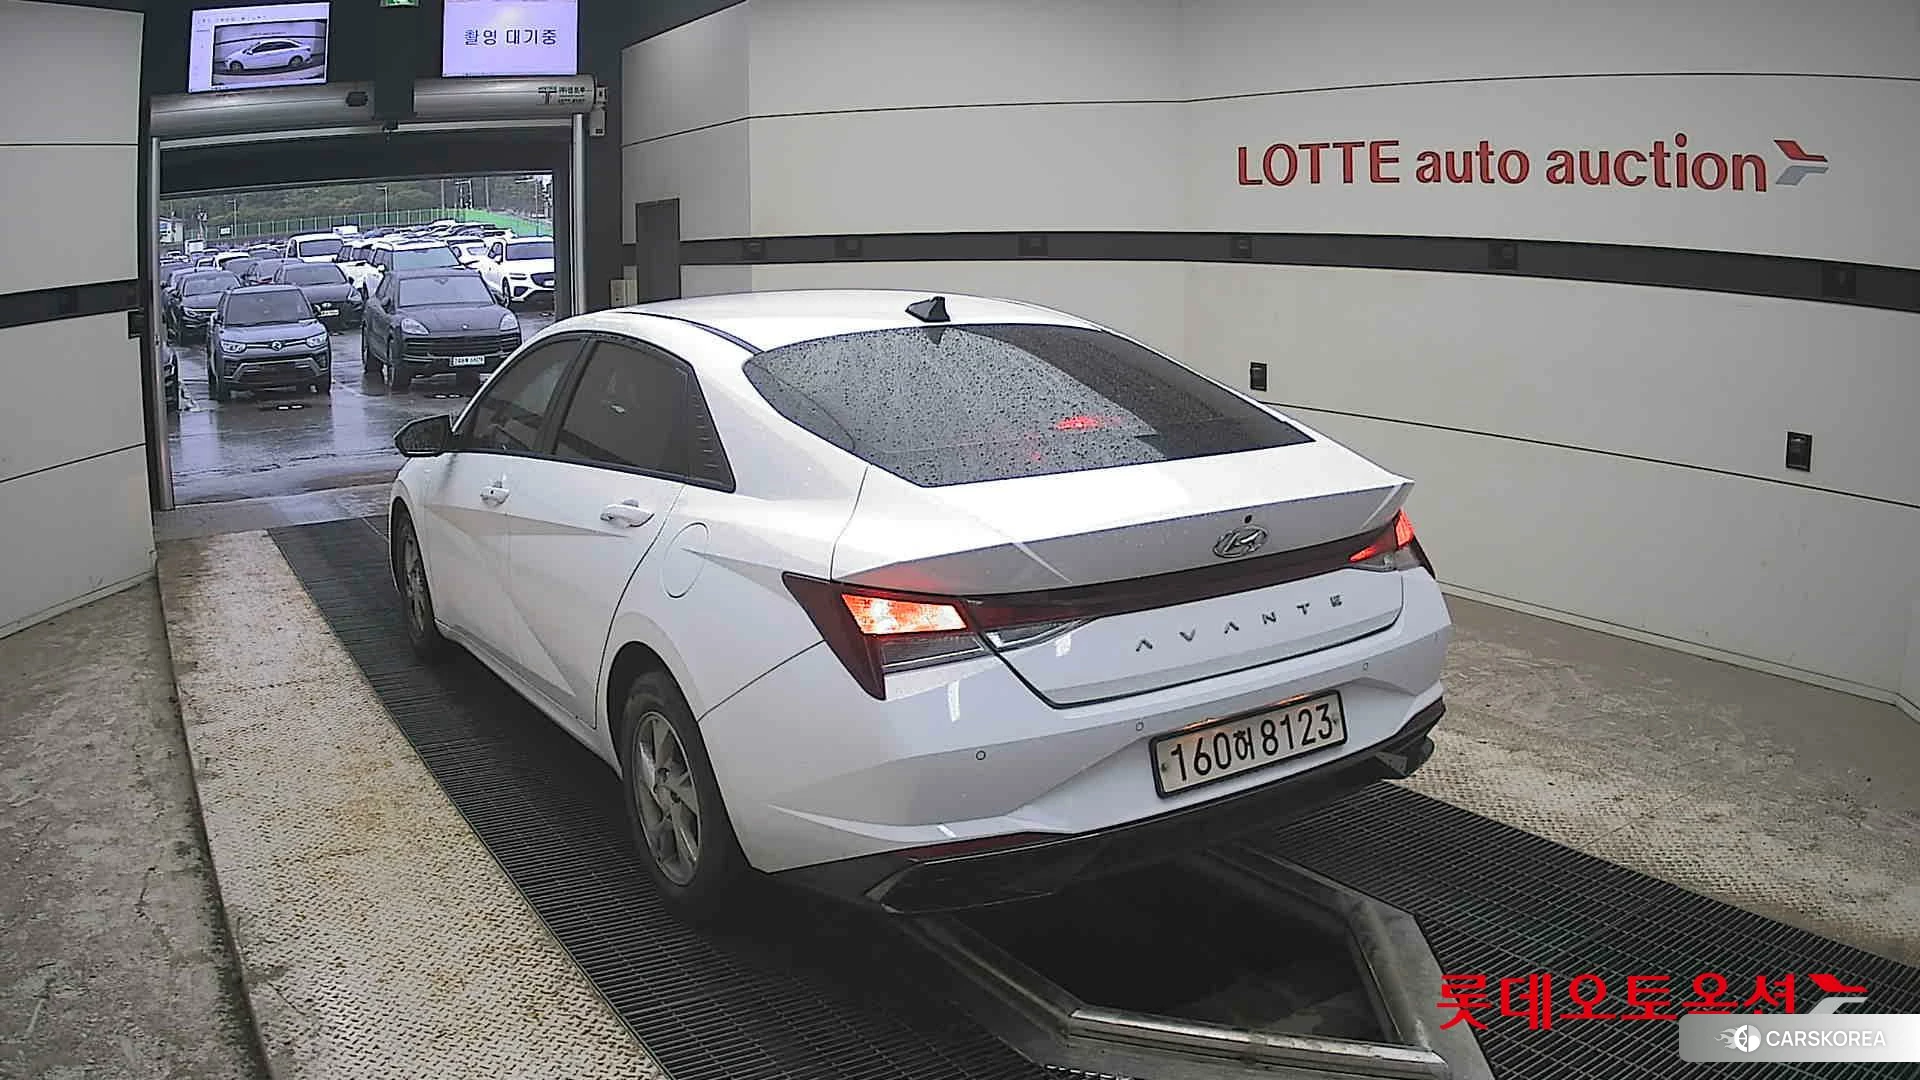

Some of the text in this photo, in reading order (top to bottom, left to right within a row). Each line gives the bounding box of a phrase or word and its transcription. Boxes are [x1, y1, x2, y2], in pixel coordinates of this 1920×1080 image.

[506, 29, 557, 46] 대기중
[1237, 132, 1768, 193] LOTTE auto auction
[1135, 594, 1343, 652] AVANTE
[1171, 704, 1334, 782] 160허8123
